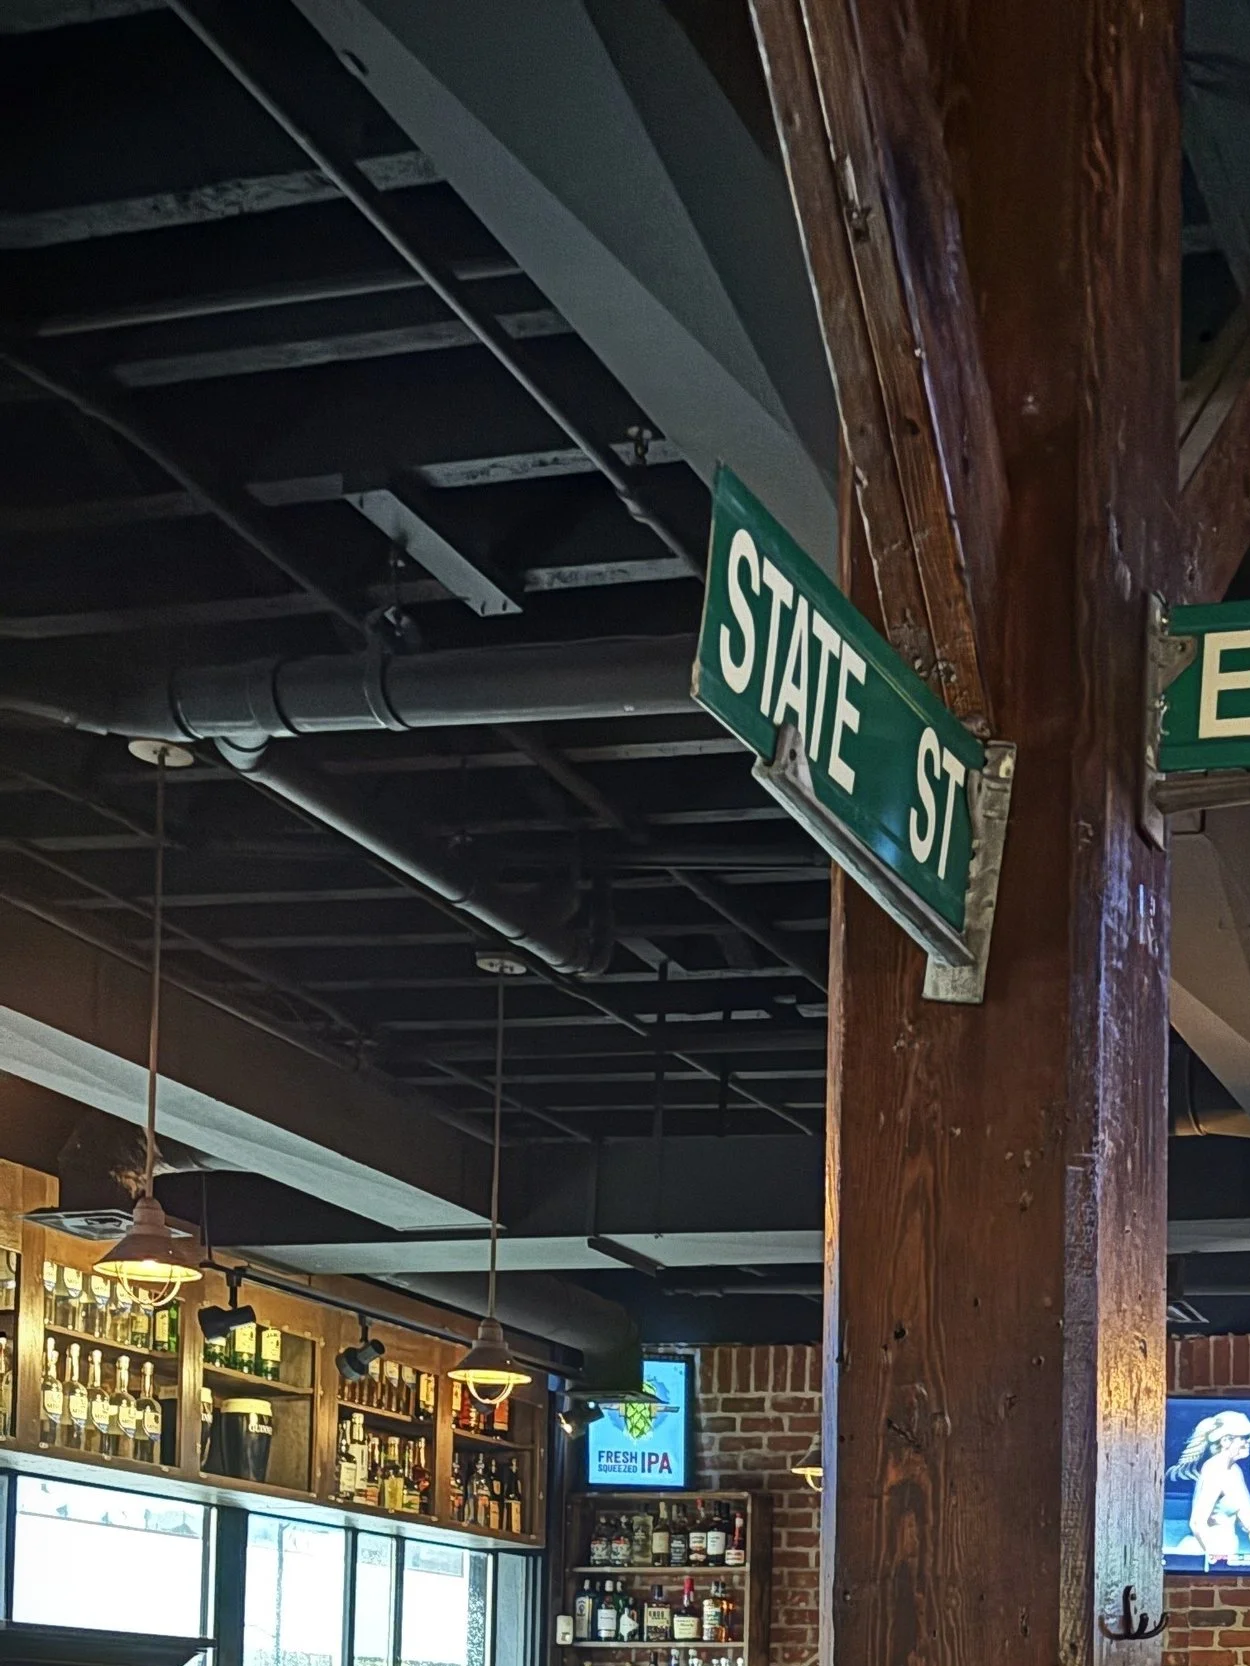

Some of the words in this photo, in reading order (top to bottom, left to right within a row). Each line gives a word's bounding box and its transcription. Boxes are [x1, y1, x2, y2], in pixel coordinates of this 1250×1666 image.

[719, 528, 867, 796] STATE
[910, 725, 966, 881] ST
[598, 1450, 637, 1464] FRESH
[641, 1452, 672, 1474] IPA
[598, 1464, 637, 1473] SQUEEZED
